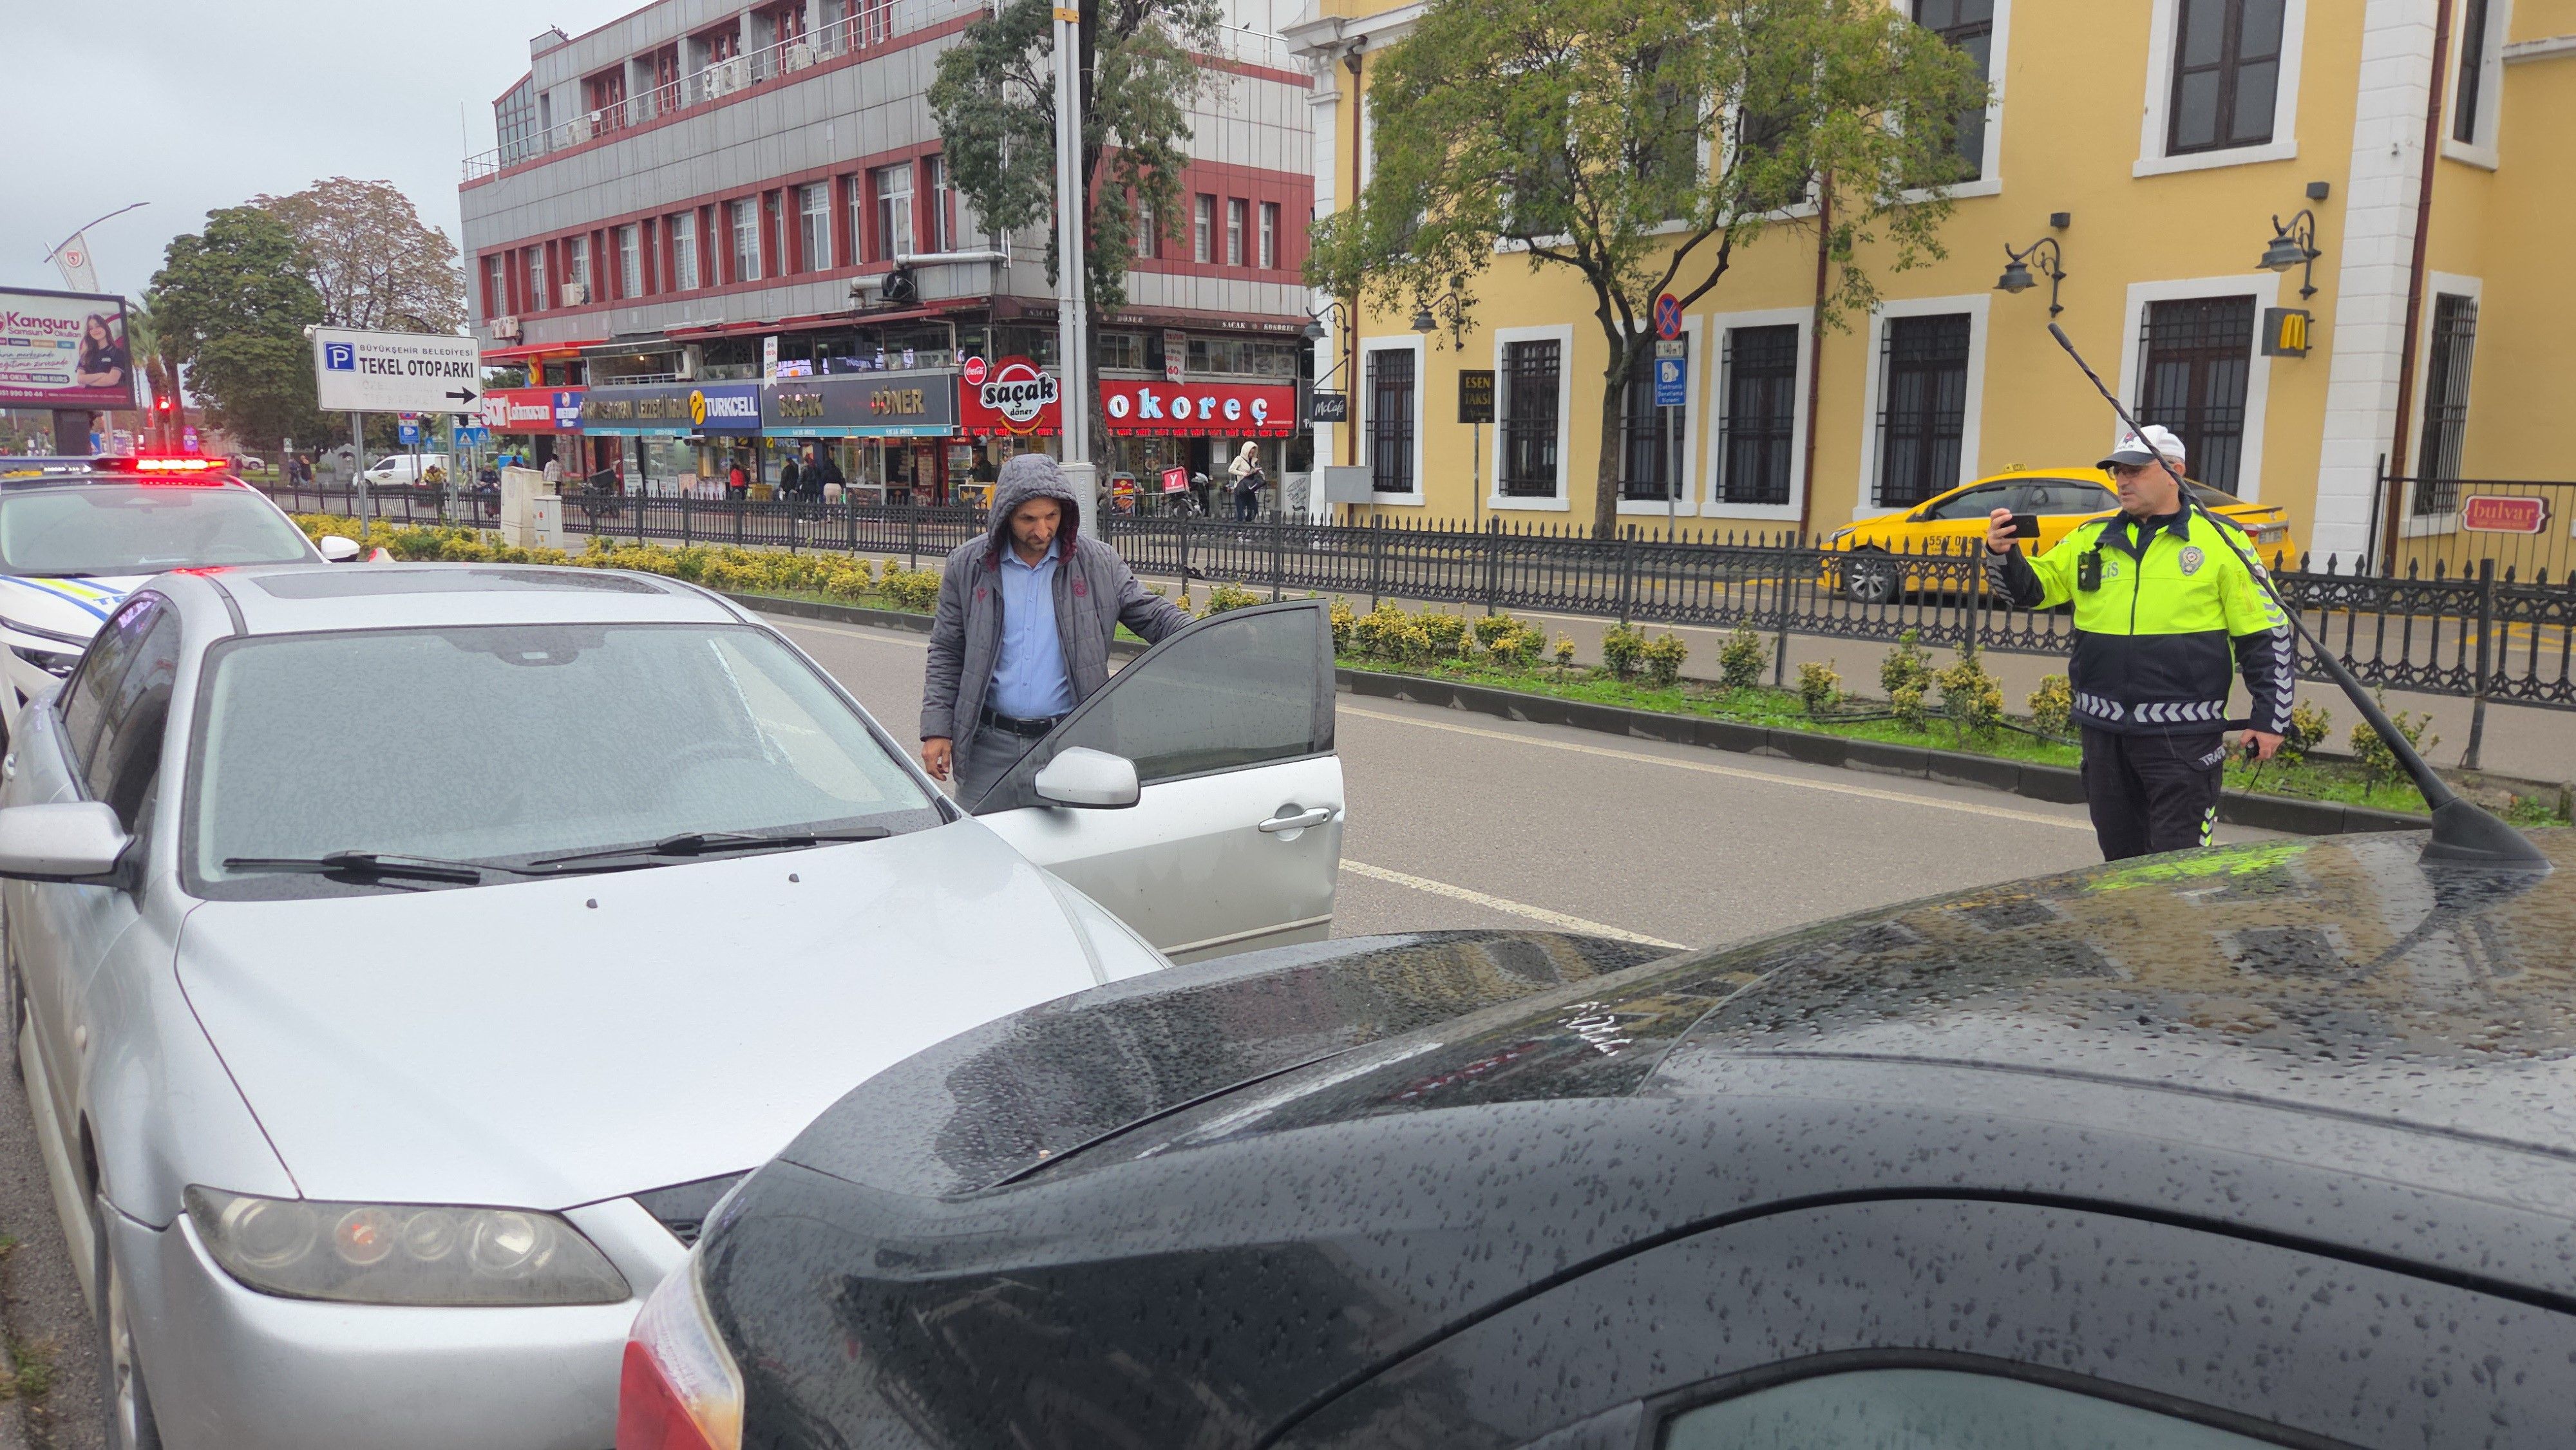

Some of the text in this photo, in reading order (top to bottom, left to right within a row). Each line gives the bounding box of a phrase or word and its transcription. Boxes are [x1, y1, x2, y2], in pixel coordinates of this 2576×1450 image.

[6, 311, 80, 334] Kanguru
[8, 327, 43, 336] Samsun
[359, 344, 473, 356] BÜYÜKŞEHİR BELEDİYESİ
[359, 357, 474, 378] TEKEL OTOPARKI
[985, 377, 1054, 408] saçak
[1465, 377, 1491, 388] ESEN
[705, 397, 758, 417] TURKCELL
[871, 384, 925, 415] DÖNER
[1108, 388, 1267, 426] okoreç
[1464, 391, 1491, 405] TAKSİ
[1315, 400, 1344, 417] McCafé
[2474, 500, 2534, 520] bulvar
[1929, 536, 1941, 546] 55
